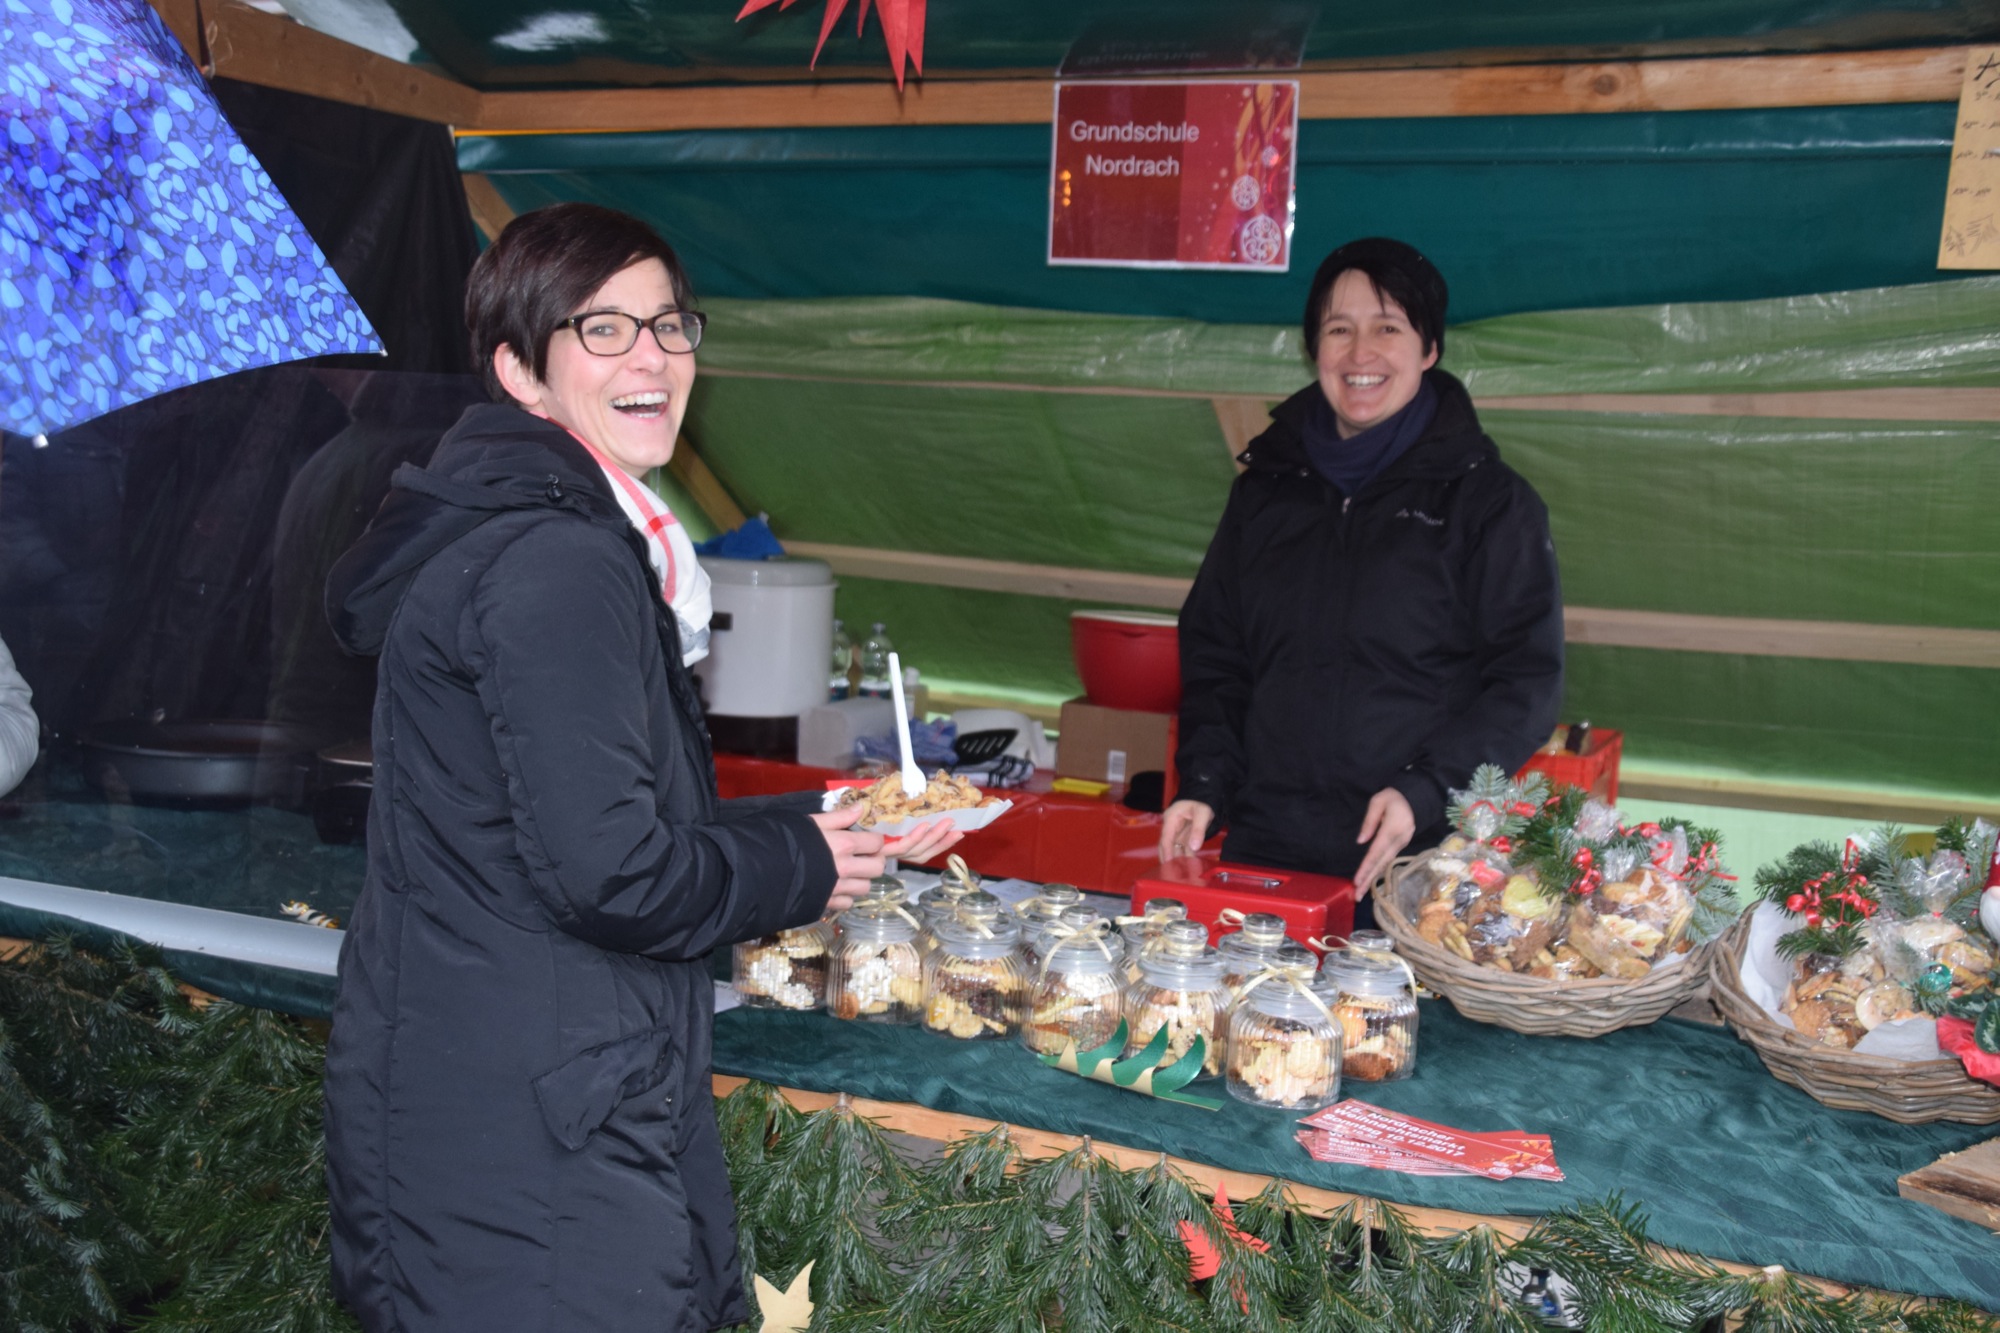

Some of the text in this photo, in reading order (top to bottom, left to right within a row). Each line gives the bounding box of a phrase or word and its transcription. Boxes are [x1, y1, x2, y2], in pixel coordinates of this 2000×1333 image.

[1070, 120, 1200, 142] Grundschule
[1085, 154, 1180, 176] Nordrach
[1322, 1114, 1383, 1136] Sonntag
[1387, 1133, 1466, 1157] 10.12.2017
[1334, 1108, 1466, 1151] Weihnachtsmarkt
[1367, 1113, 1455, 1141] Nordracher
